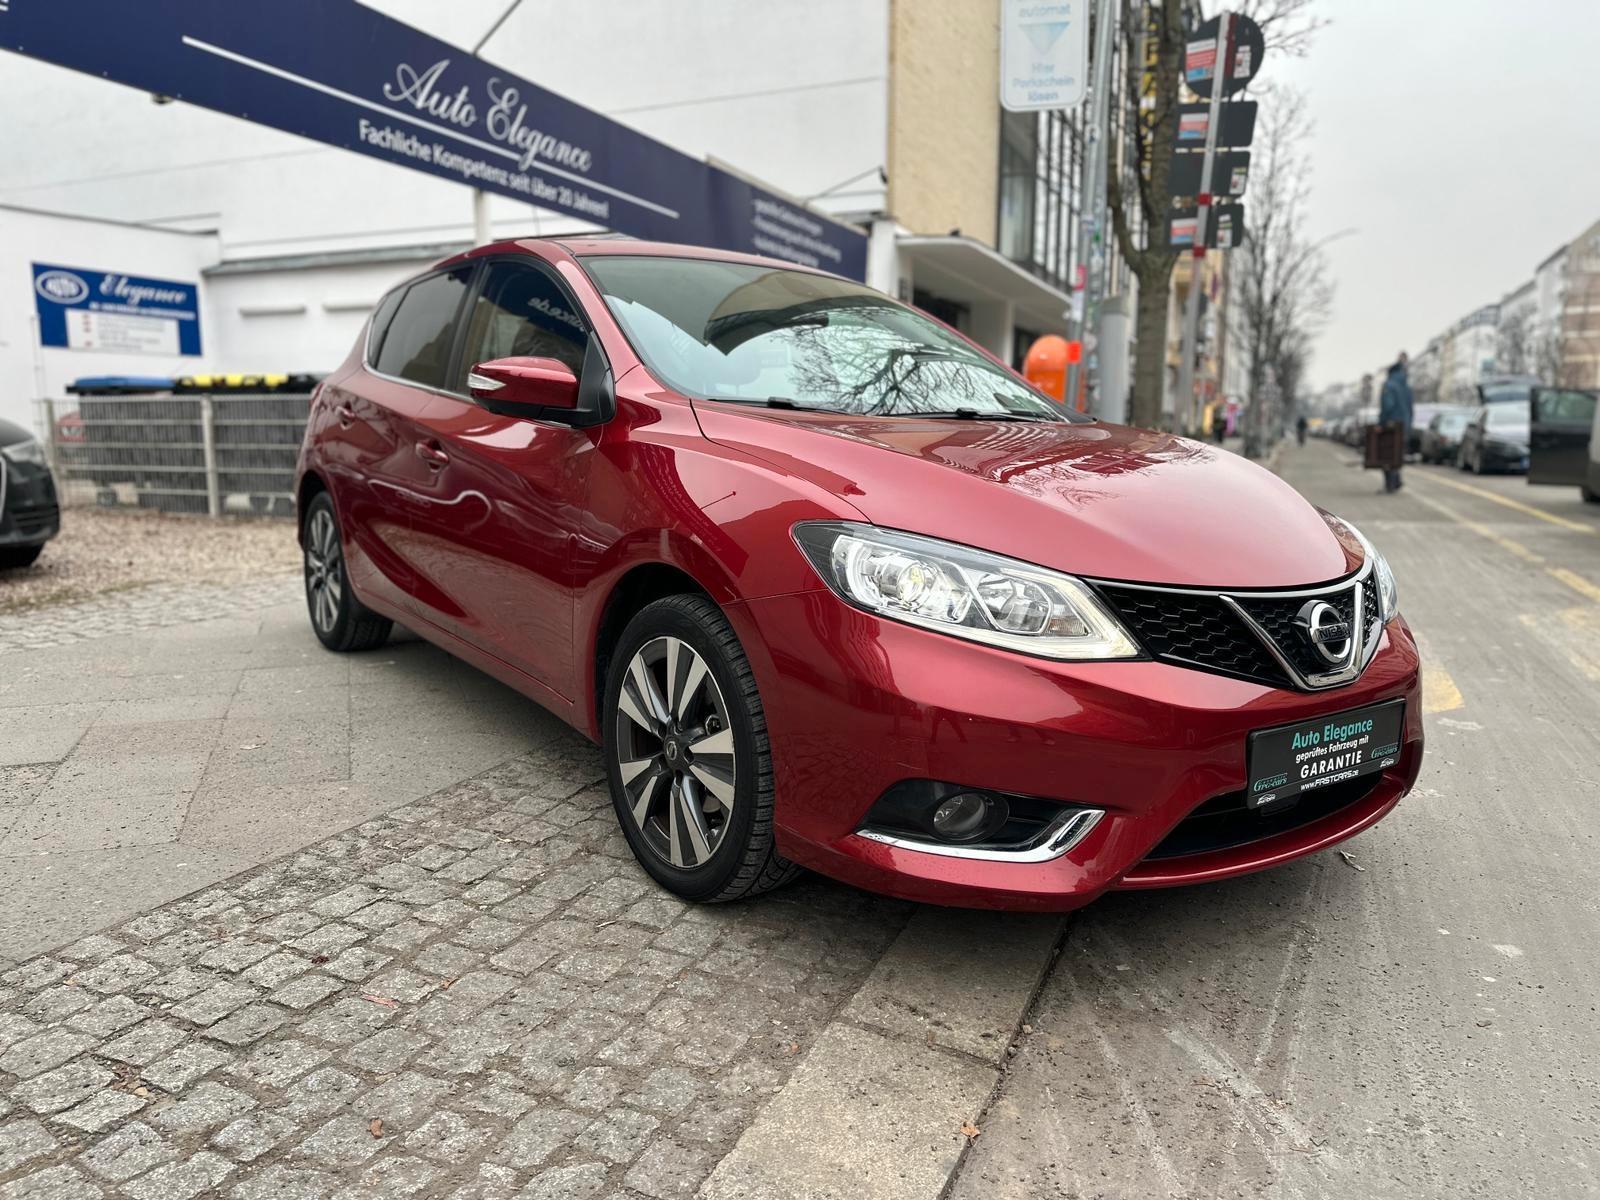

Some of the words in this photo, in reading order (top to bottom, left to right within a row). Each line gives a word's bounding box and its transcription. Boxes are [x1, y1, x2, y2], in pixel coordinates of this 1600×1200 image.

[383, 58, 477, 128] Auto
[486, 76, 593, 172] Elegance
[358, 117, 432, 162] Fachliche
[432, 142, 508, 184] Kompetenz
[509, 169, 531, 194] seit
[1291, 731, 1320, 750] Auto
[1323, 719, 1373, 742] Elegance
[1295, 746, 1328, 764] geprüftes
[1328, 739, 1358, 753] Fahrzeug
[1358, 734, 1369, 745] mit
[1300, 750, 1362, 779] GARANTIE
